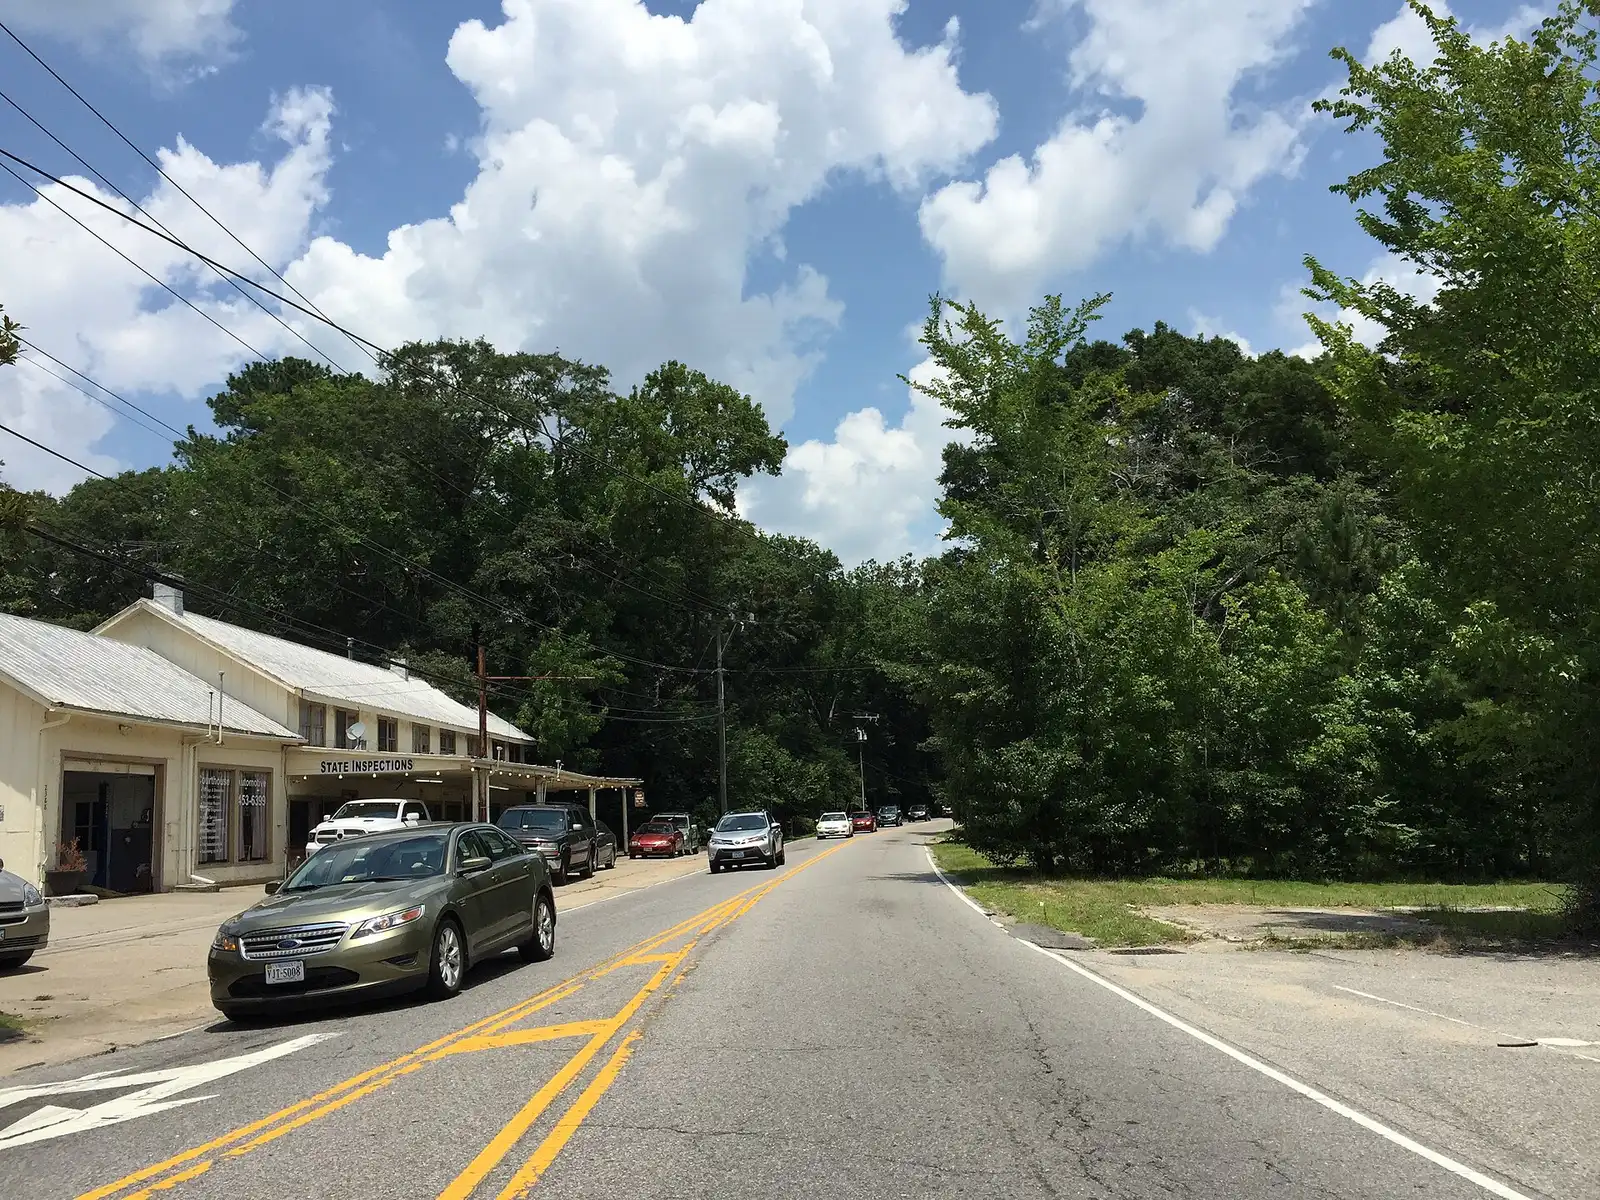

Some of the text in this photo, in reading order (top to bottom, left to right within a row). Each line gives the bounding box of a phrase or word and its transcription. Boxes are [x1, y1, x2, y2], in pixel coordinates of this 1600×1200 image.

[320, 759, 413, 773] STATE INSPECTIONS
[200, 775, 230, 786] ourthouse
